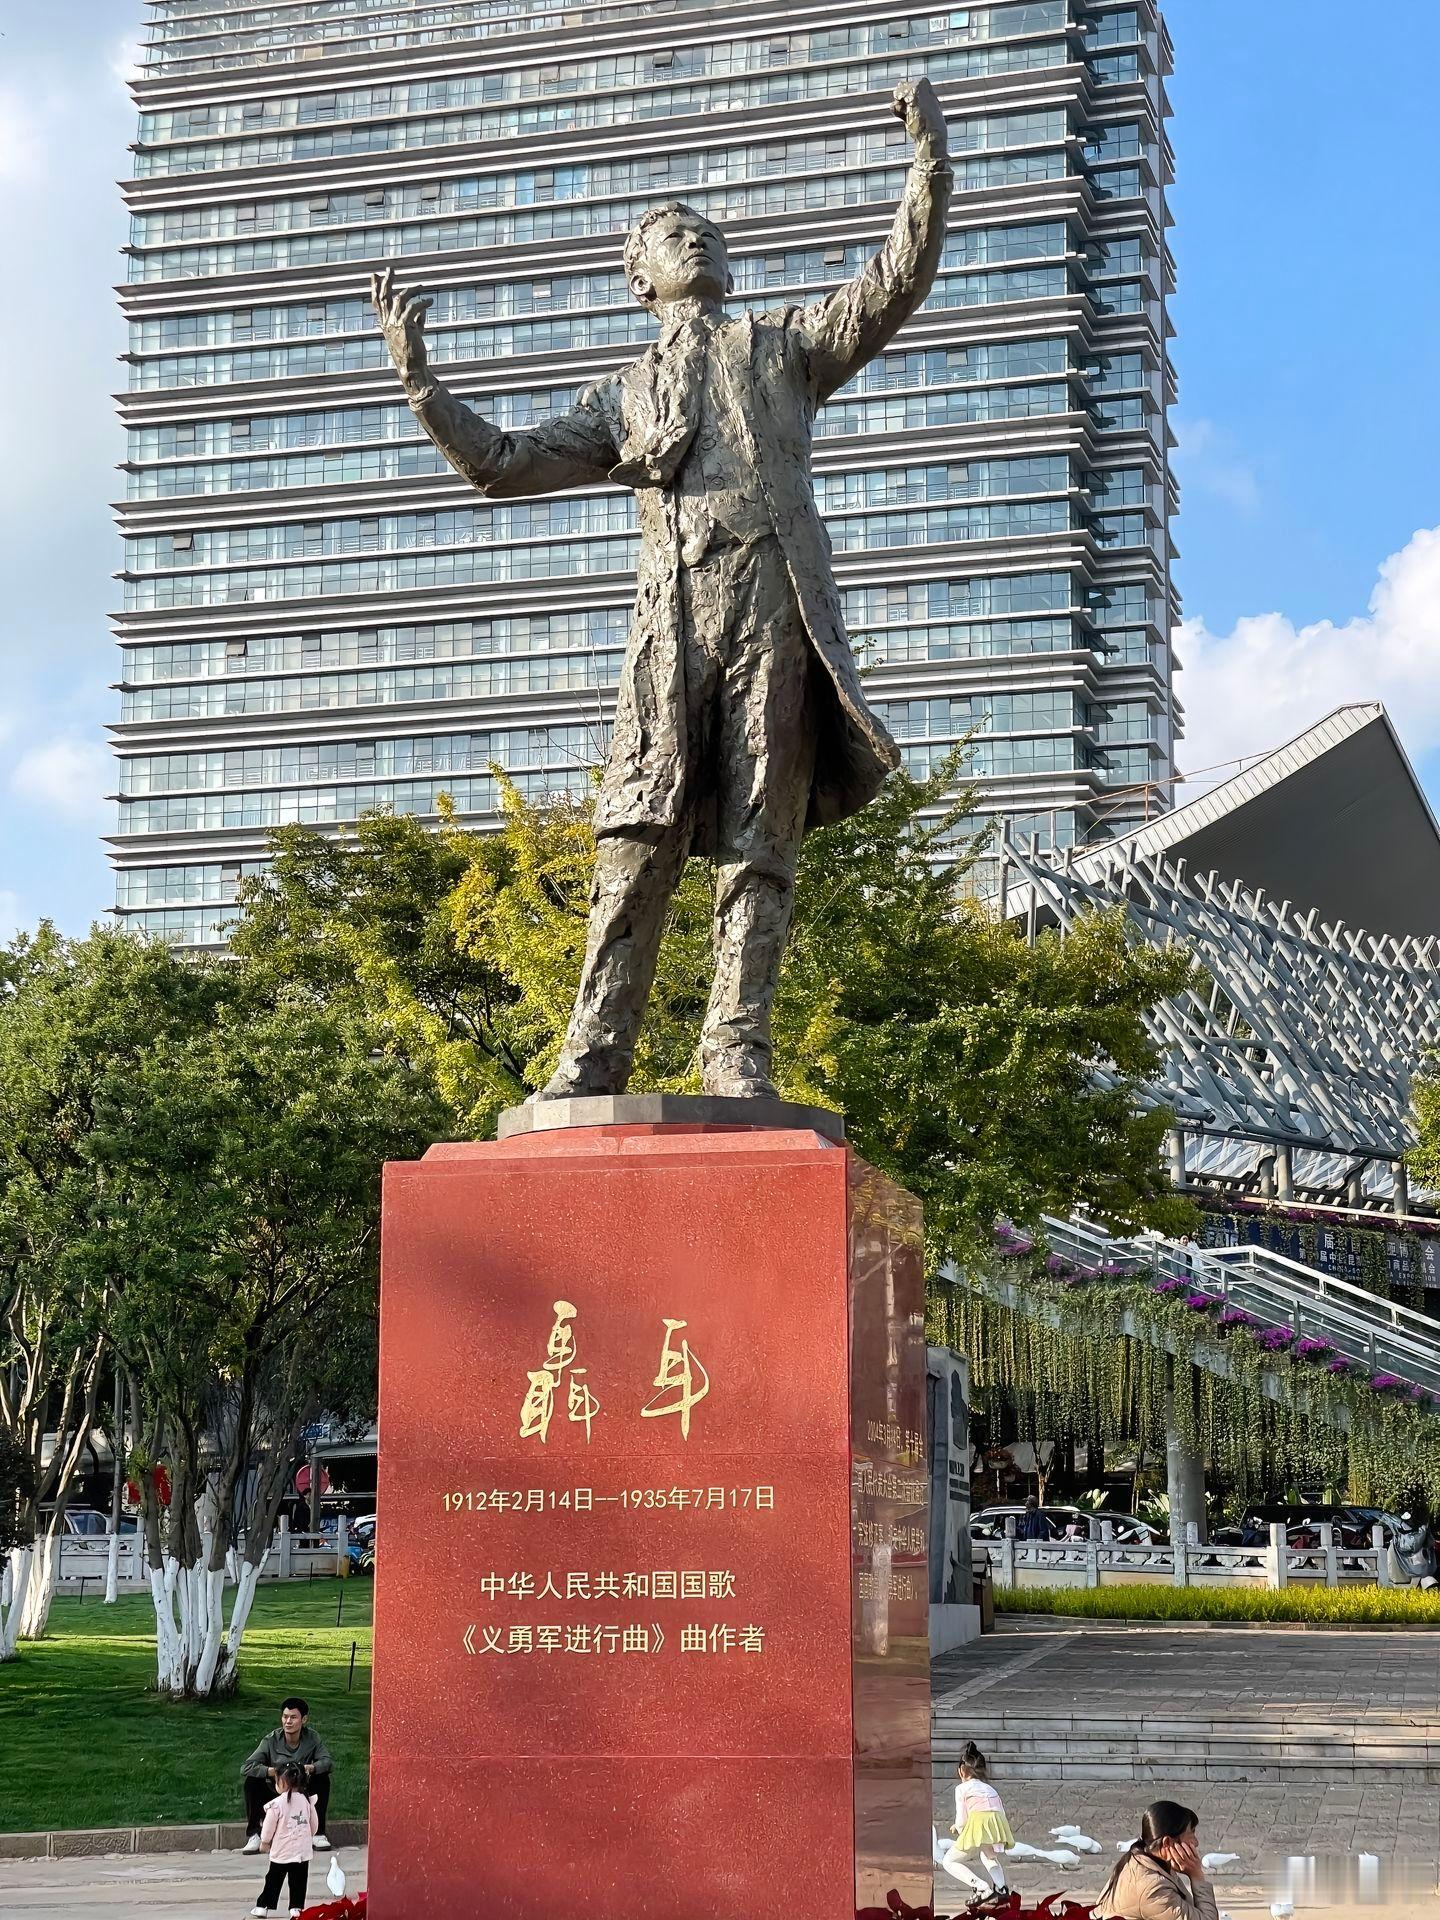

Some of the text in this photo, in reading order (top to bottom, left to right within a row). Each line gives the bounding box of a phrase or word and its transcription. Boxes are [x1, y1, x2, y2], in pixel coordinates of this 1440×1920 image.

[480, 1570, 736, 1600] 中华人民共和国国歌
